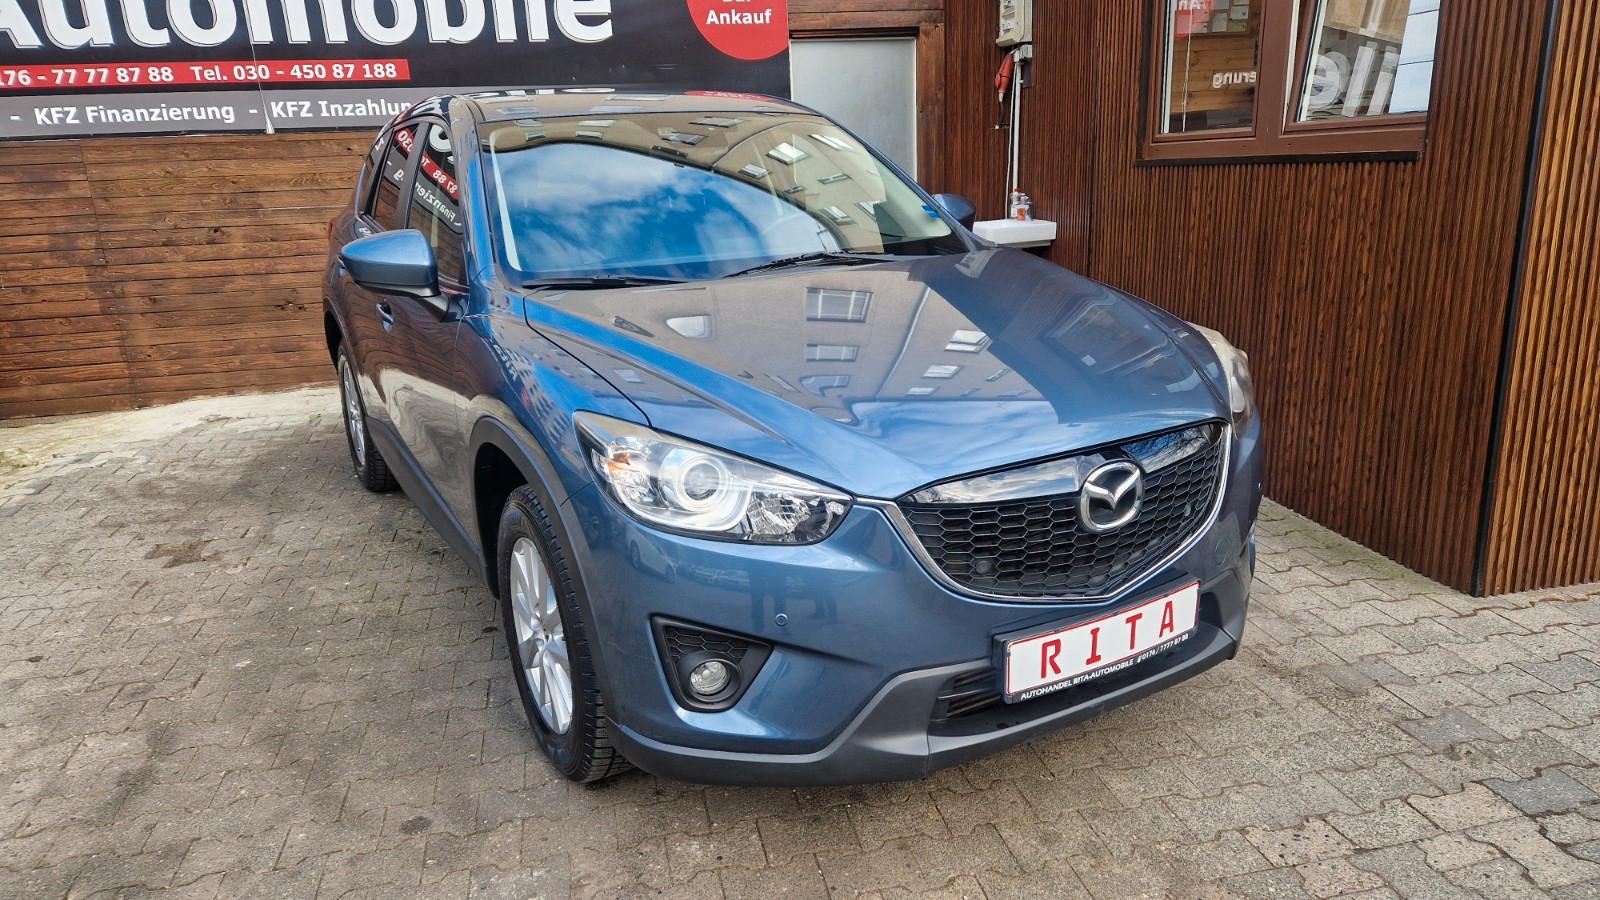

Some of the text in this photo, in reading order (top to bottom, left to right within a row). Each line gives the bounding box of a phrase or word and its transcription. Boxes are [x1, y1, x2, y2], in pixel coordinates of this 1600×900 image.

[706, 8, 772, 25] Ankauf
[51, 68, 77, 85] 77
[84, 67, 109, 84] 77
[115, 67, 140, 83] 87
[148, 66, 174, 82] 88
[190, 65, 228, 81] Tel.
[233, 64, 270, 80] 030
[290, 63, 326, 79] 450
[332, 62, 355, 78] 87
[362, 63, 397, 78] 188
[34, 106, 81, 126] KFZ
[85, 104, 235, 124] Finanzierung
[270, 101, 313, 118] KFZ
[1020, 679, 1072, 700] AUTOHANDEL
